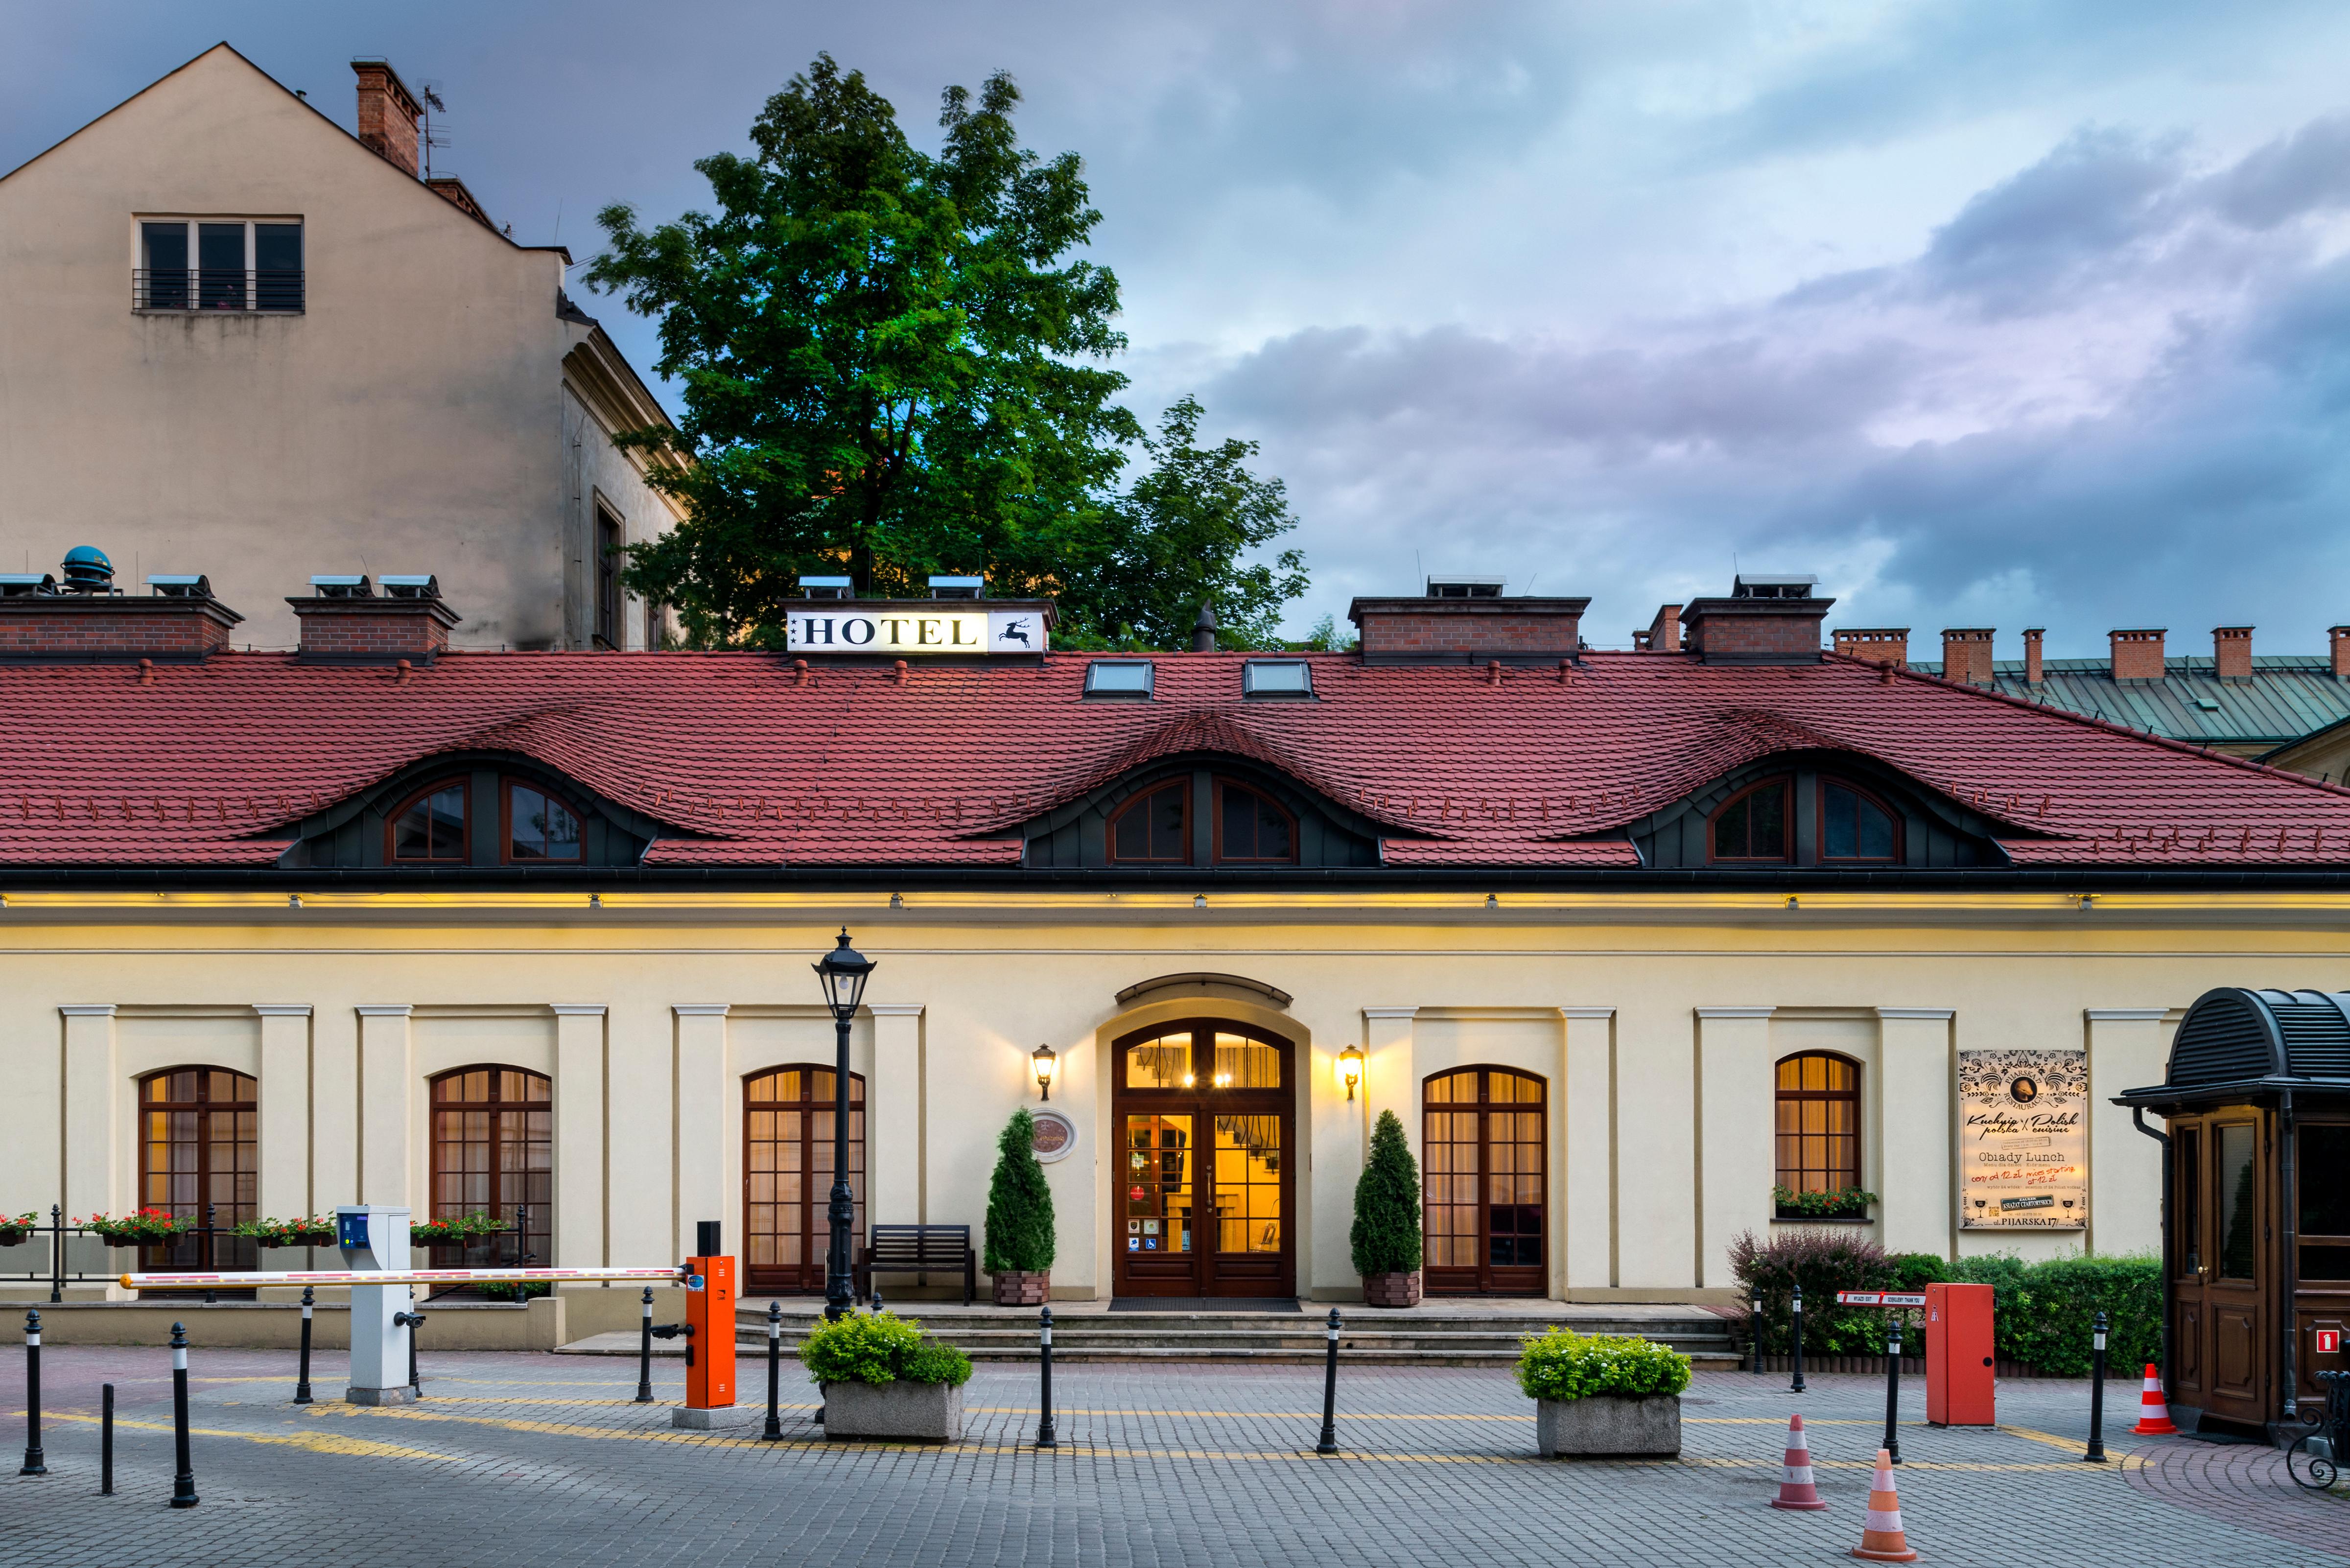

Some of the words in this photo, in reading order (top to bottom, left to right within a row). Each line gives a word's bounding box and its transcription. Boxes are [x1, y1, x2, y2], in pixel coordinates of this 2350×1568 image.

[801, 618, 977, 645] HOTEL
[2005, 1070, 2036, 1084] PIJARSKA
[2004, 1093, 2044, 1110] RESTAURACJA
[1967, 1112, 2020, 1126] Kuchnia
[2031, 1112, 2079, 1127] Polish
[1979, 1122, 2020, 1141] polska
[2032, 1125, 2070, 1133] cuisine
[1979, 1152, 2022, 1163] Obiady
[2026, 1152, 2065, 1162] Lunch
[1989, 1172, 1998, 1181] od
[2001, 1171, 2012, 1179] 12
[2026, 1169, 2044, 1178] prices
[2021, 1199, 2052, 1208] CZARTORYSKICH
[2001, 1218, 2046, 1226] PIJARSKA
[2047, 1217, 2057, 1228] 17
